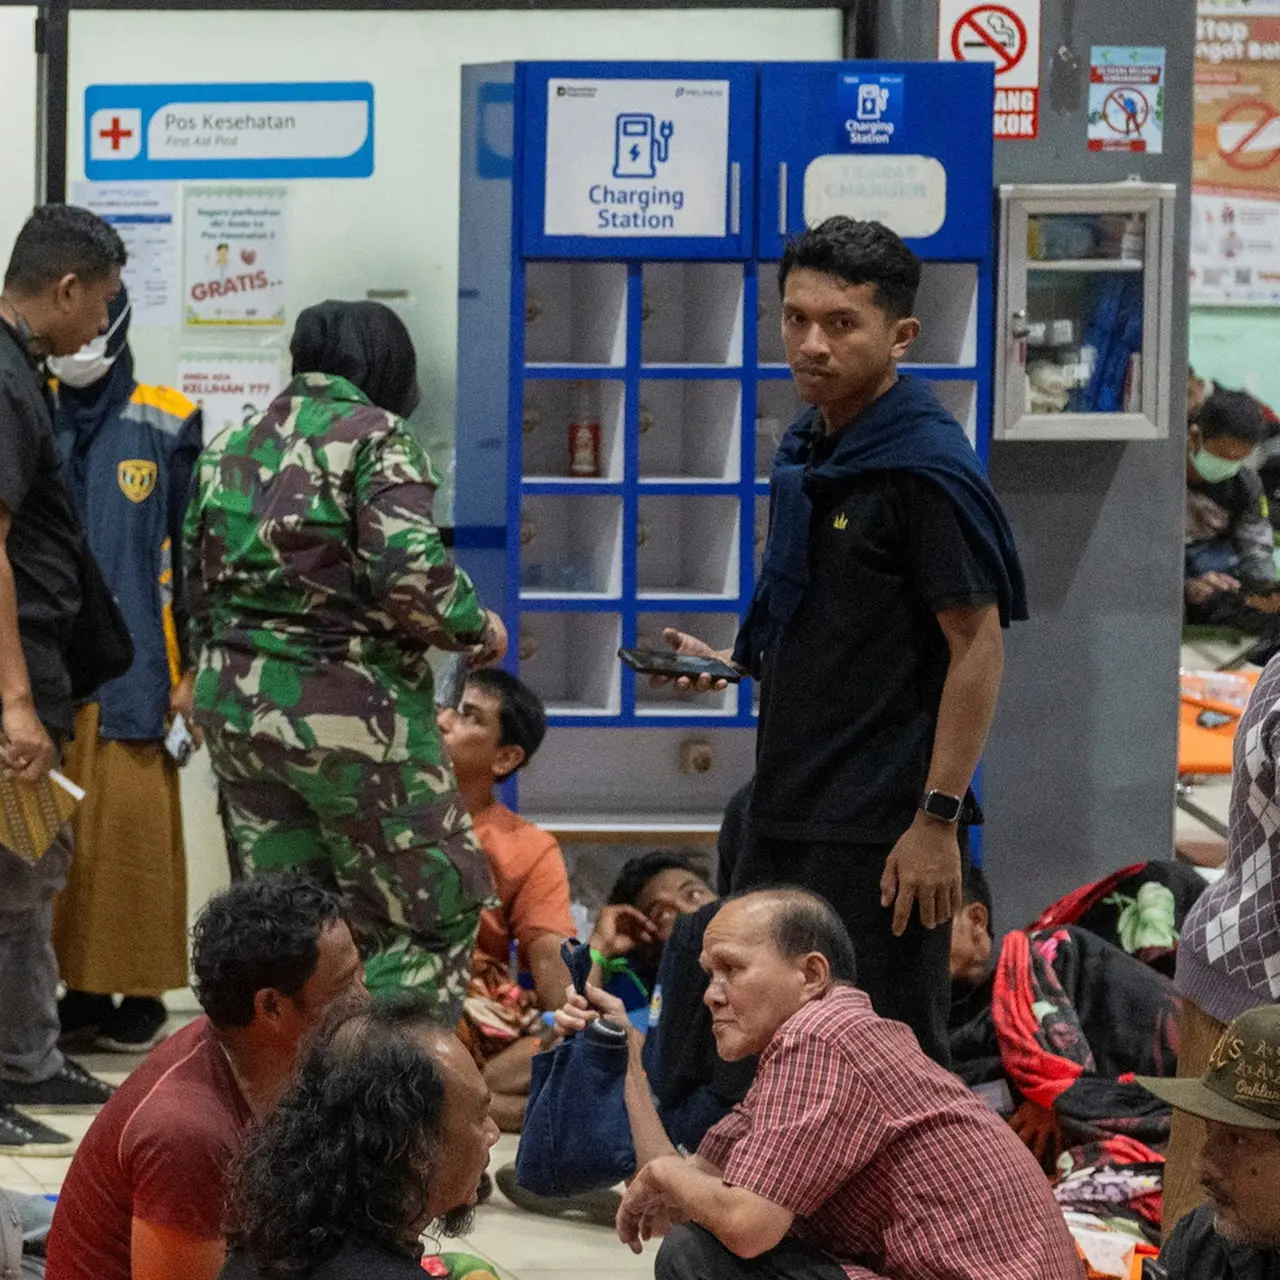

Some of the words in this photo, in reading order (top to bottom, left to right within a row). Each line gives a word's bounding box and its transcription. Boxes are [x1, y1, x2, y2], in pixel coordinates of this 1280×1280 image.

[994, 91, 1034, 111] ANG
[165, 114, 197, 131] Pos
[203, 113, 296, 130] Kesehatan
[844, 119, 894, 135] Charging
[994, 114, 1034, 135] KOK
[850, 133, 889, 145] Station
[588, 184, 684, 209] Charging
[598, 209, 674, 229] Station
